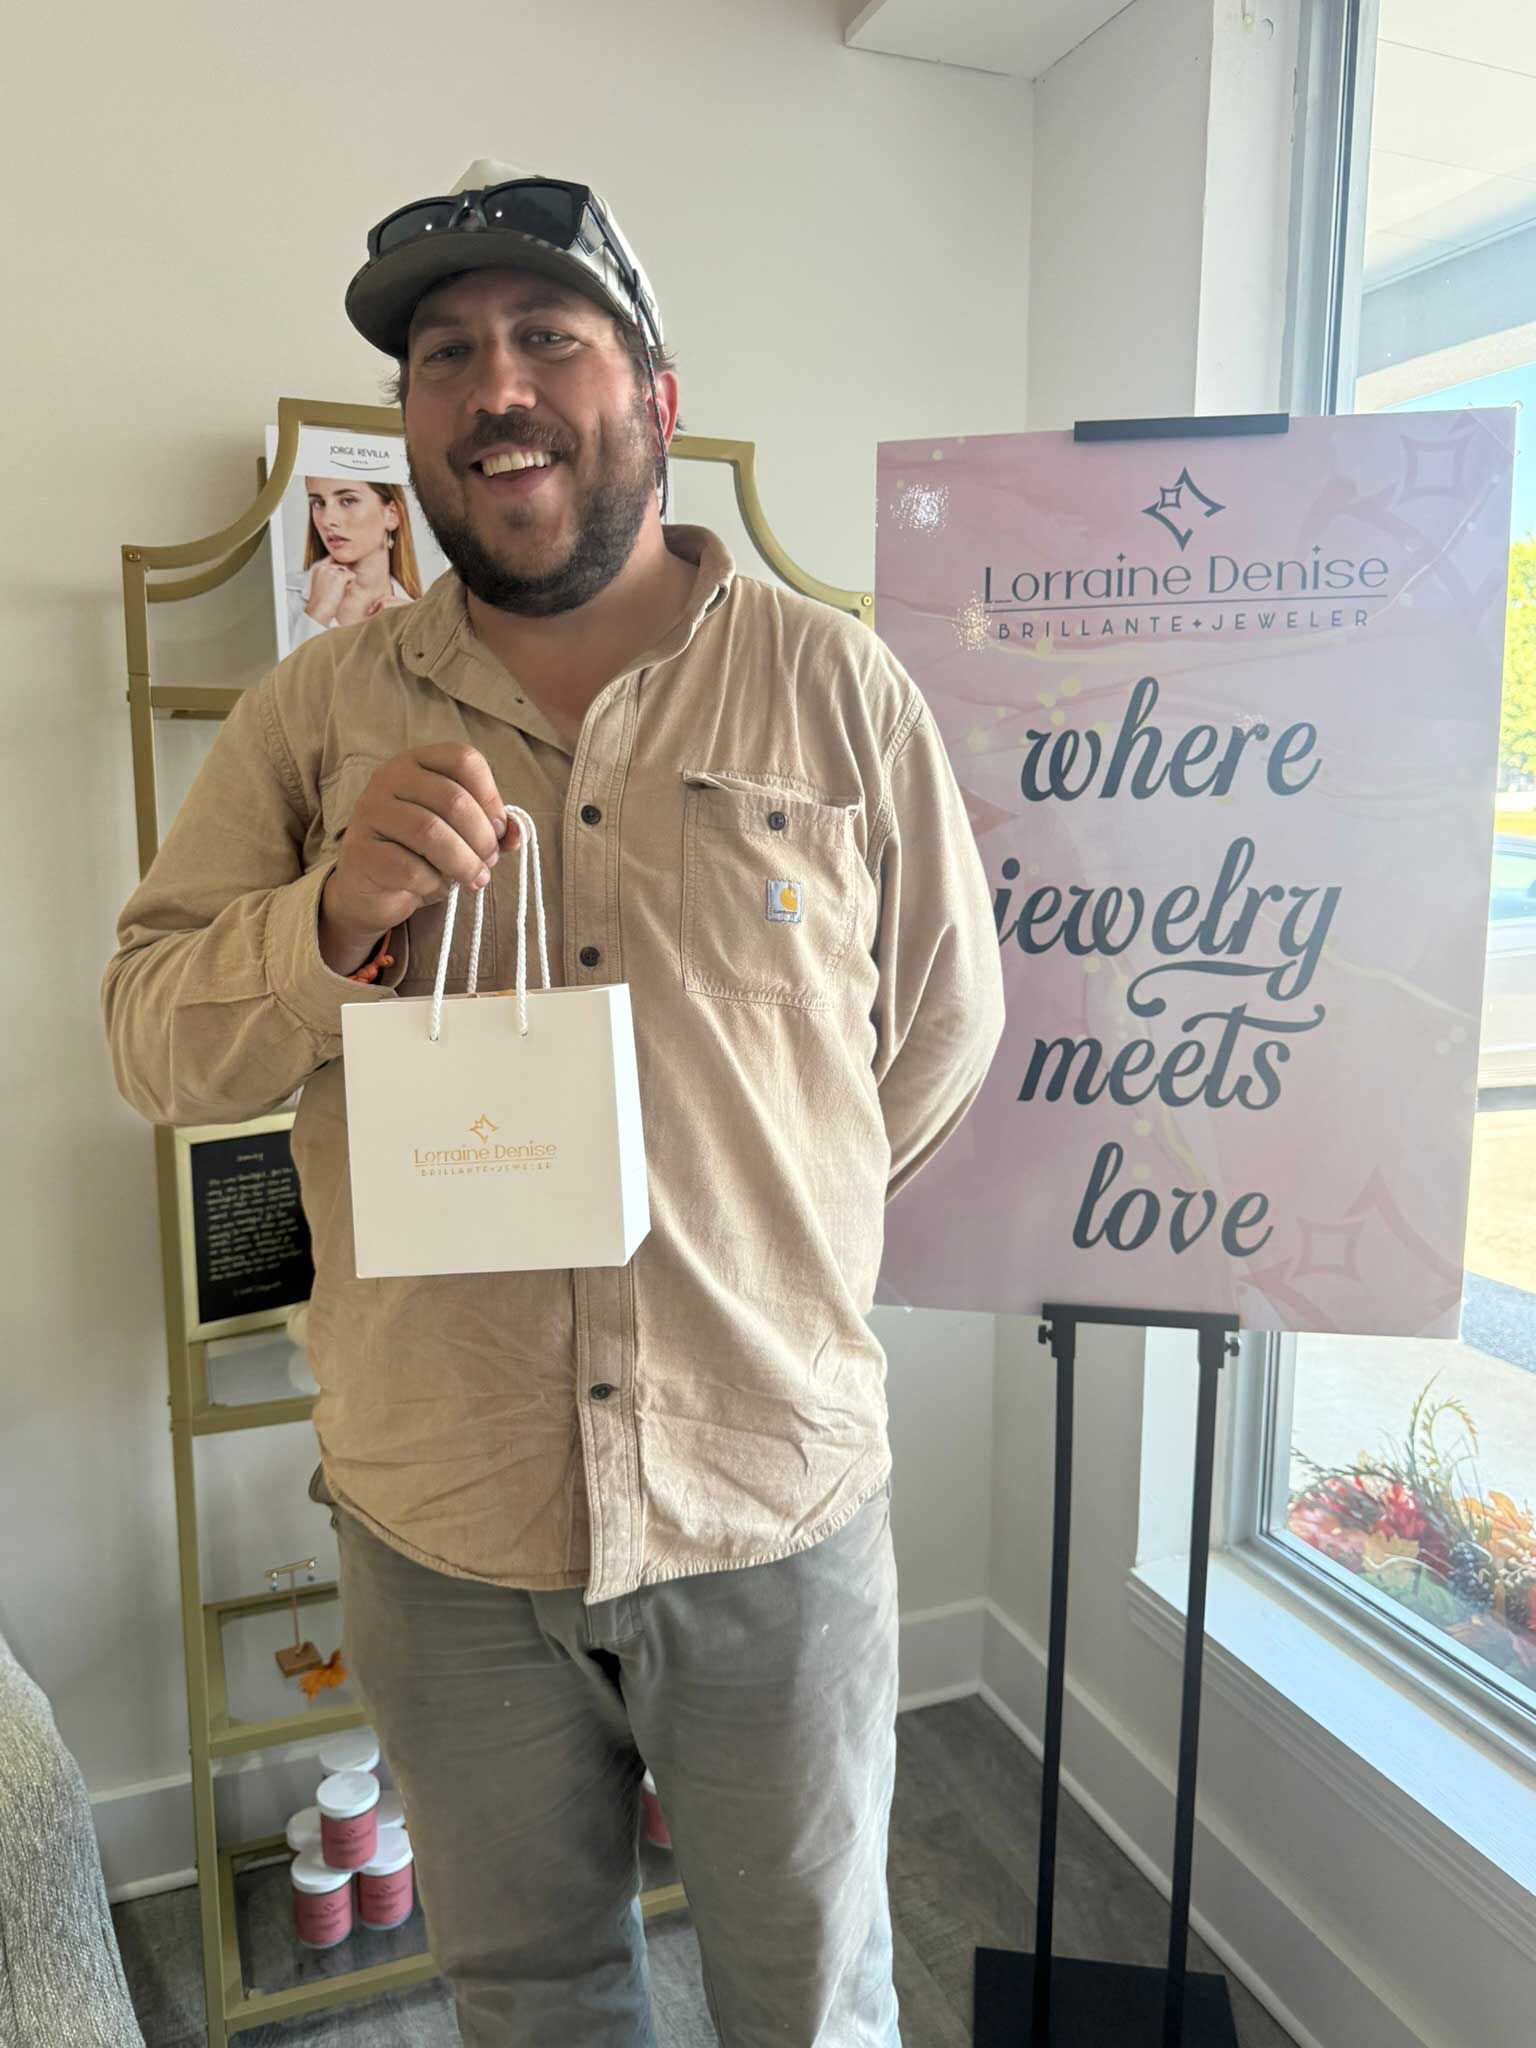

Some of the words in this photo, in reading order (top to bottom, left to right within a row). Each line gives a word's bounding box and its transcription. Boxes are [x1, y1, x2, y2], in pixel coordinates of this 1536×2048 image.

[330, 445, 354, 456] JORGE
[357, 447, 390, 459] REVILLA
[983, 552, 1192, 605] Lorraine
[1208, 544, 1390, 595] Denise
[1019, 676, 1323, 803] where
[1017, 1002, 1326, 1111] meets
[414, 1144, 490, 1164] Lorraine
[494, 1139, 557, 1160] Denise
[1072, 1141, 1274, 1258] love
